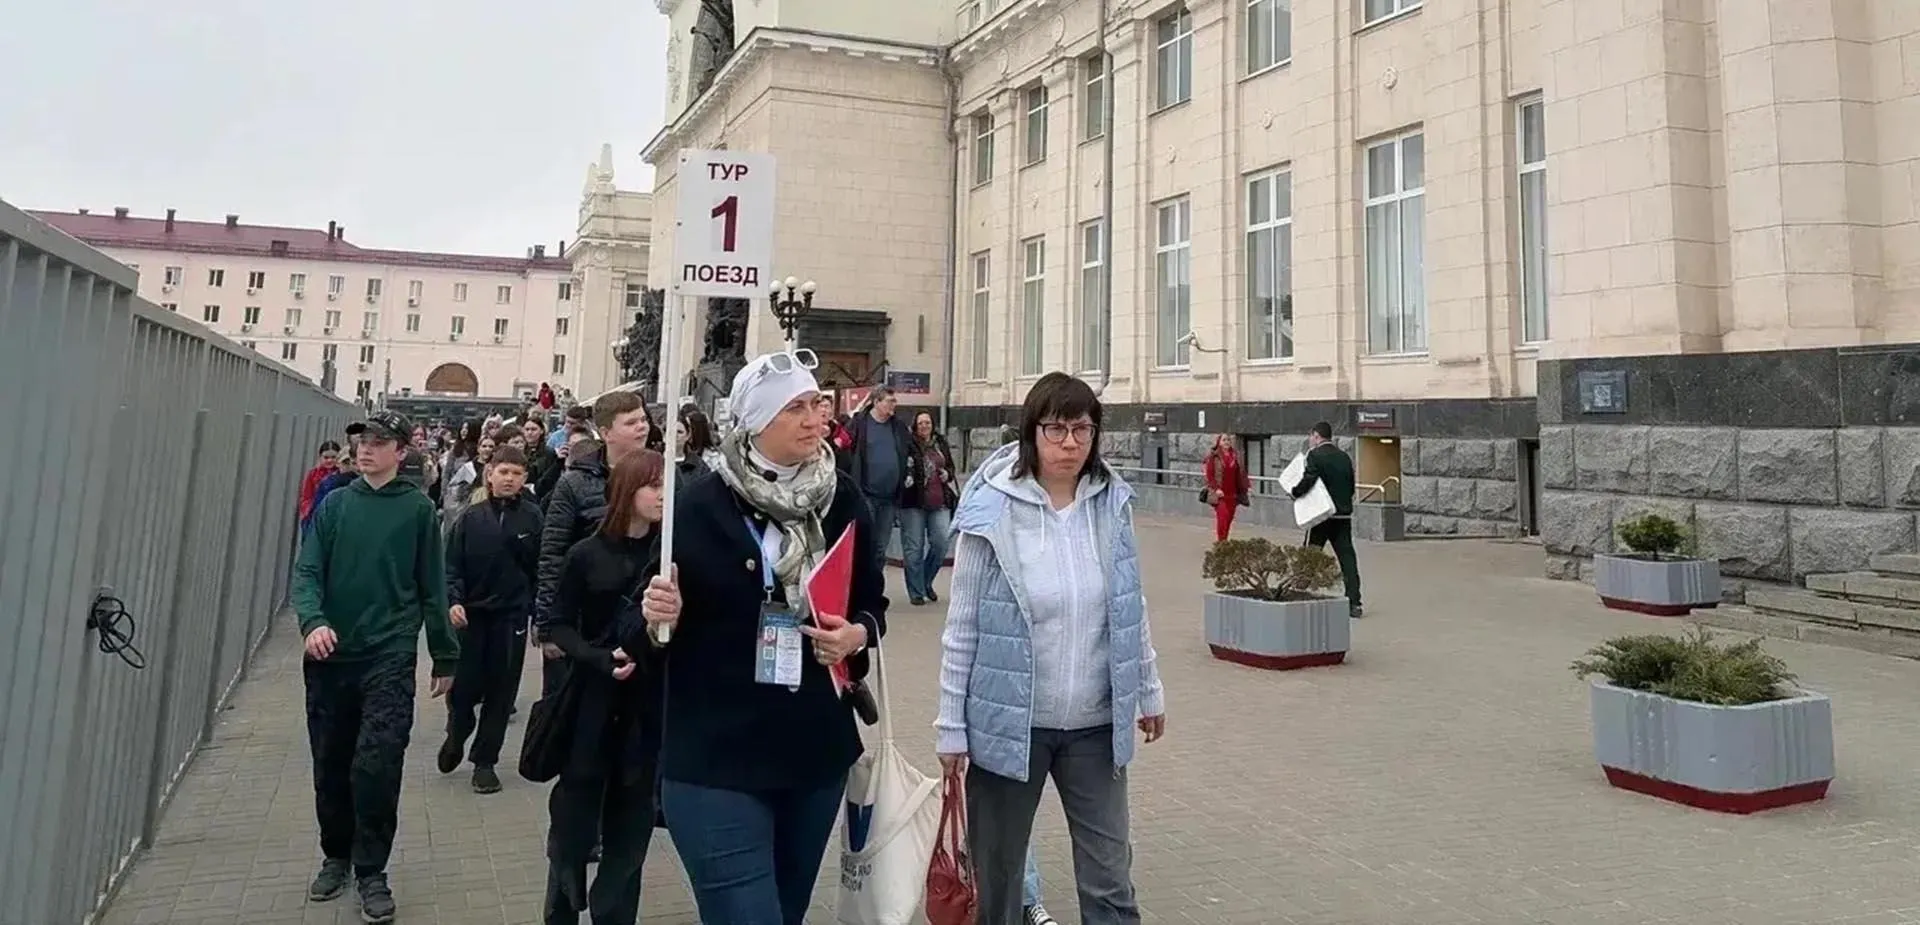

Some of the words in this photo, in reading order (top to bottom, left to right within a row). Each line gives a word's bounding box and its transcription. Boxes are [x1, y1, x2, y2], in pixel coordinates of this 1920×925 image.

[707, 163, 749, 181] ТУР
[711, 196, 738, 252] 1
[683, 264, 759, 287] ПОЕЗД
